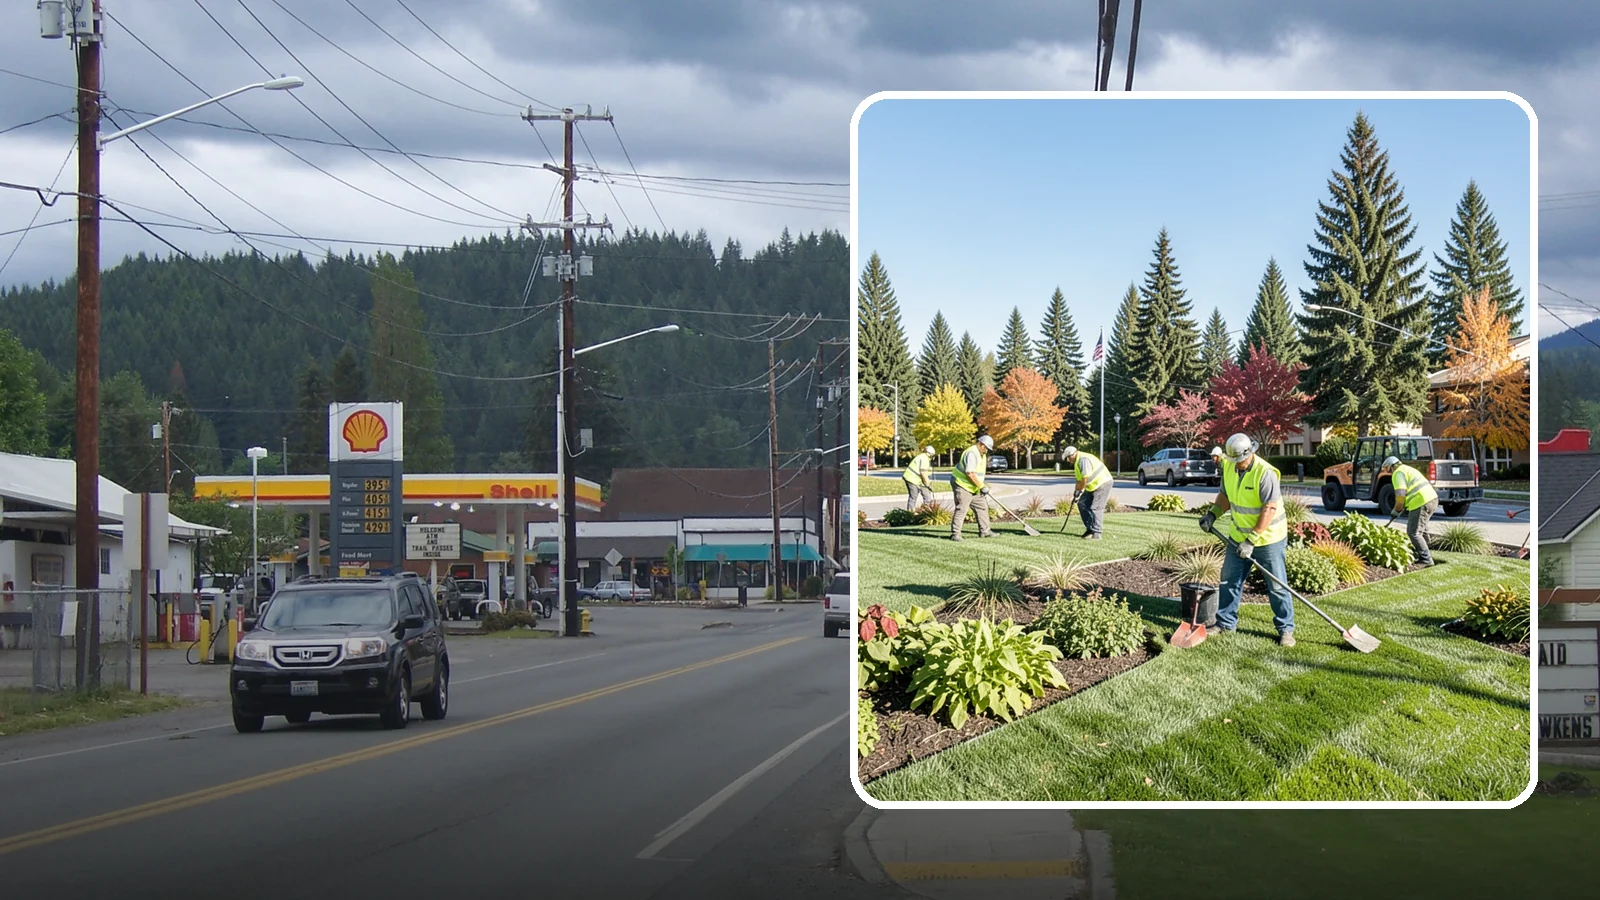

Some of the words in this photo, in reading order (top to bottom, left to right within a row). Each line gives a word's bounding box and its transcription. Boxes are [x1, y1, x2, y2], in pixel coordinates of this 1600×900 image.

[366, 480, 383, 490] 395
[490, 484, 547, 499] Shell
[366, 494, 383, 504] 405
[366, 508, 383, 518] 415
[366, 522, 383, 532] 429
